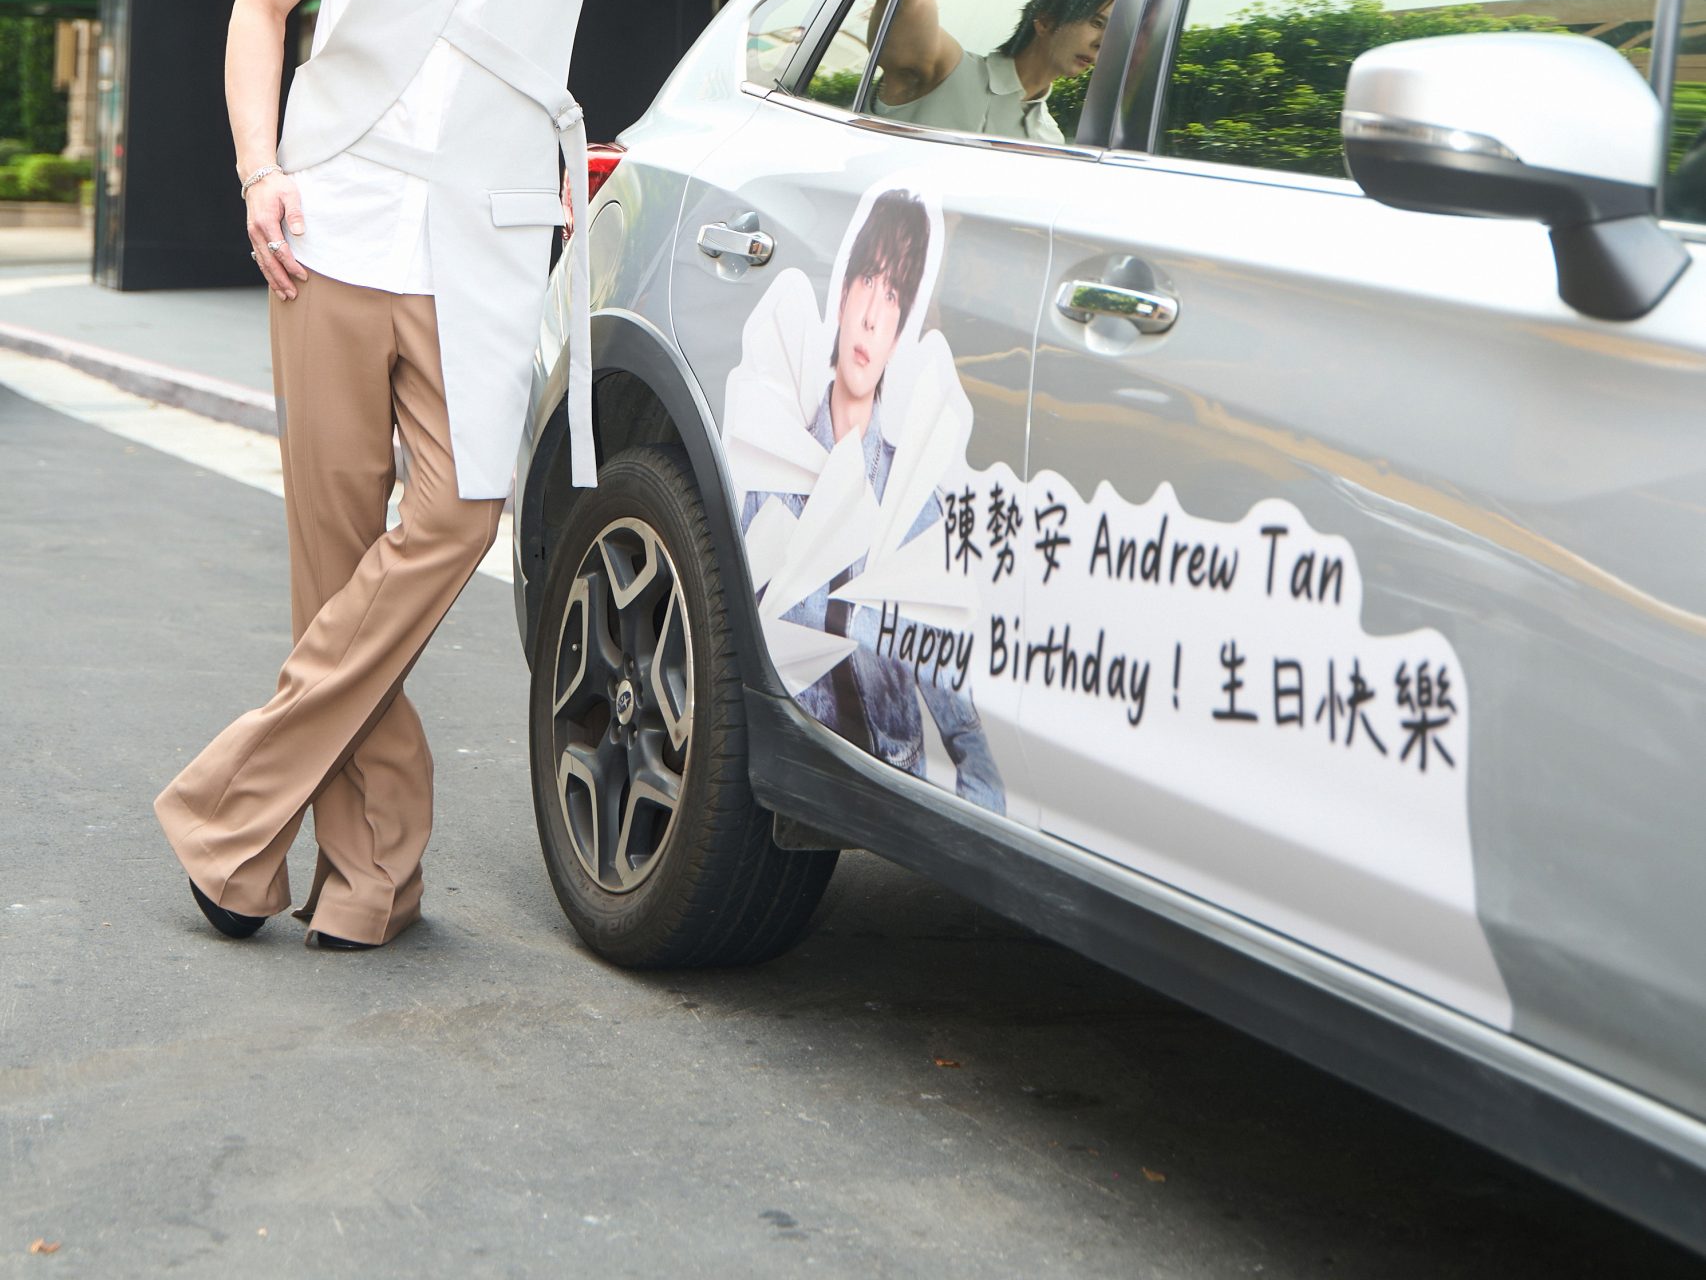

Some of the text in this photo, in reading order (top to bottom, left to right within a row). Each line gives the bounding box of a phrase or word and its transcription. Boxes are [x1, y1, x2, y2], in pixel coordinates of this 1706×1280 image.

[944, 484, 1343, 604] 陳勢安 Andrew Tan
[876, 600, 974, 692] Happy
[1212, 639, 1457, 771] 生日快樂
